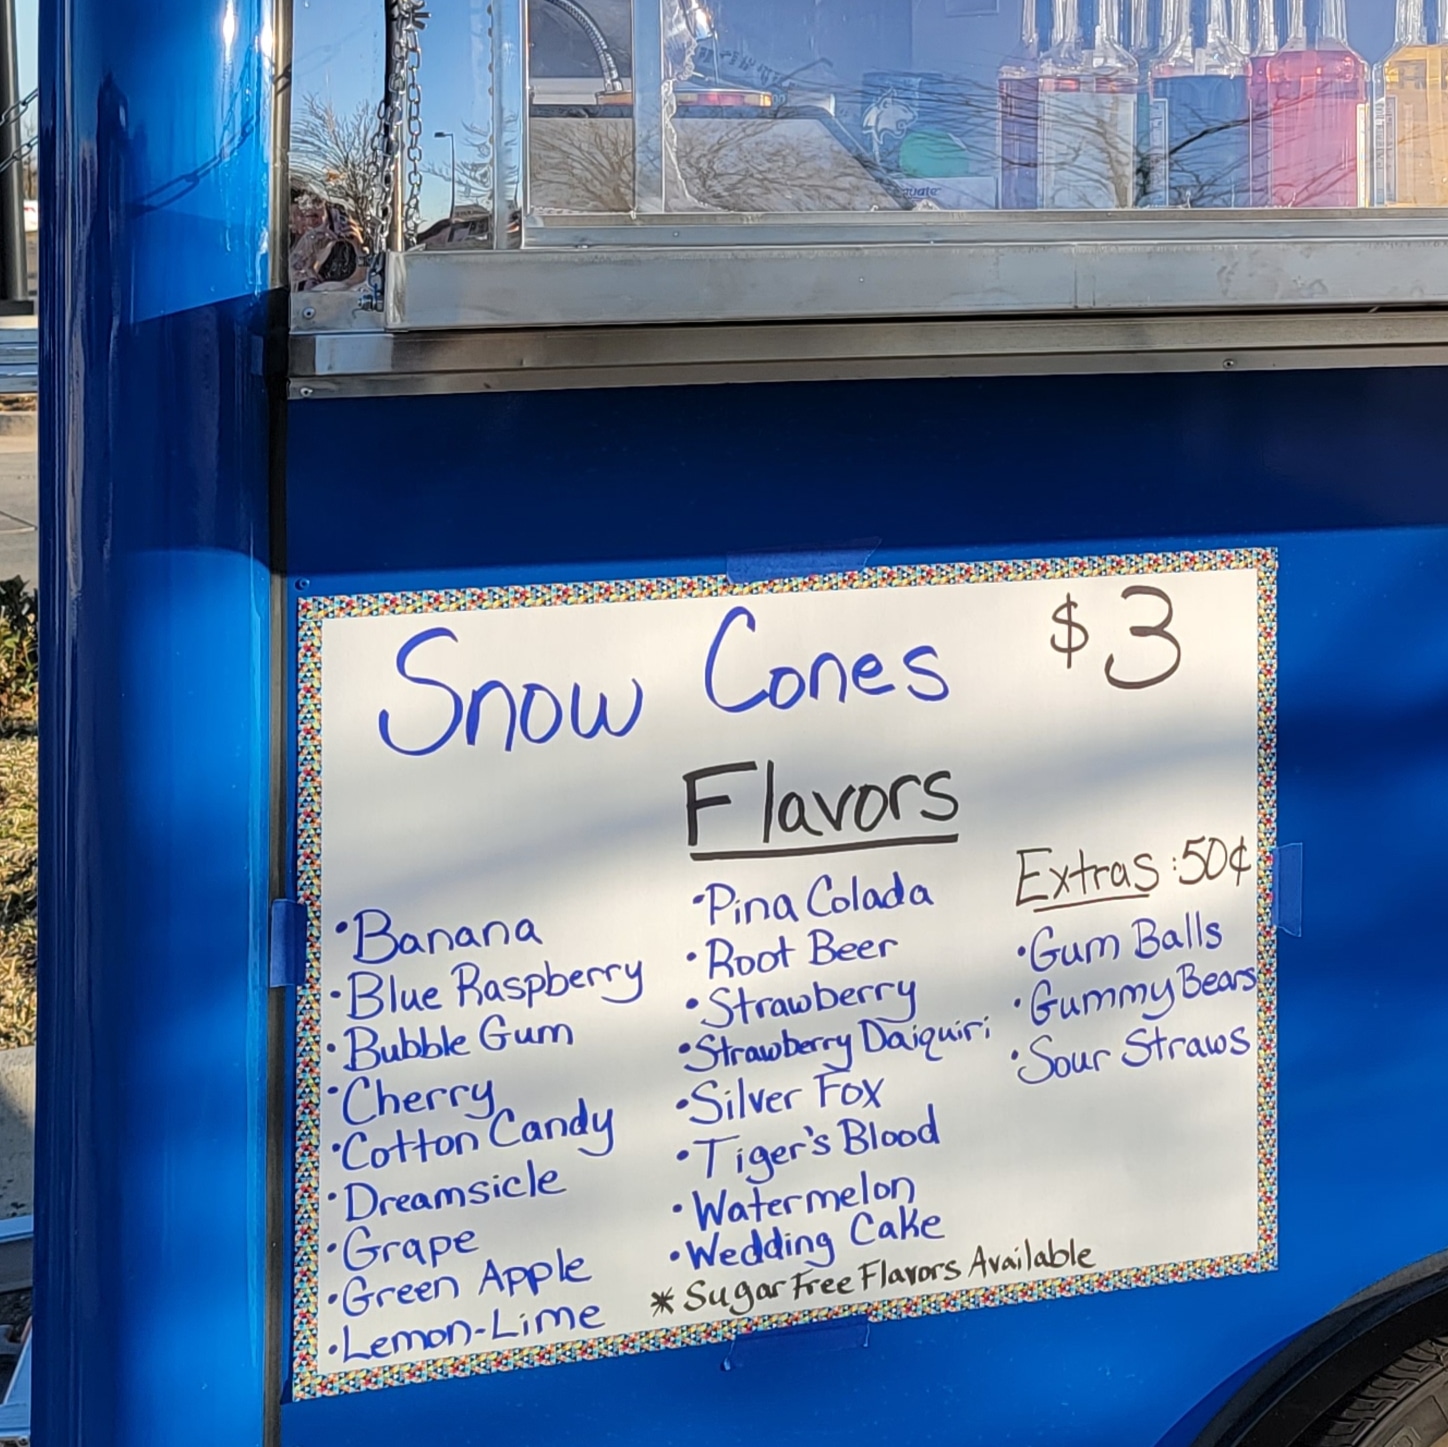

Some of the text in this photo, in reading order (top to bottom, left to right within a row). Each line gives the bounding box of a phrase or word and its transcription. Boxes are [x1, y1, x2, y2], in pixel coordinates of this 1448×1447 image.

[378, 585, 1182, 754] Snow Cones $3
[684, 761, 960, 846] Flavors
[705, 871, 934, 926] Pina Colada
[353, 909, 543, 964] Banana
[705, 929, 898, 979] Root Beer
[1030, 911, 1222, 972] Gum Balls
[347, 960, 643, 1020] Blue Raspberry
[700, 981, 916, 1028] Strawberry
[1031, 963, 1257, 1026] Gummy Bears
[343, 1014, 574, 1072] Bubble Gum
[684, 1016, 990, 1072] Strawberry Daiquiri
[1018, 1026, 1251, 1084] Sour Straws
[342, 1076, 496, 1125] Cherry
[690, 1070, 884, 1125] Silver Fox
[341, 1097, 614, 1171] Cotton Candy
[693, 1103, 940, 1184] Tiger's Blood
[344, 1159, 567, 1222] Dreamsicle
[691, 1170, 915, 1231] Watermelon
[343, 1226, 479, 1271] Grape
[685, 1205, 945, 1270] Wedding Cake
[343, 1248, 592, 1317] Green Apple
[683, 1238, 1097, 1316] Sugar Free Flavors Available
[343, 1304, 606, 1363] Lemon-Lime
